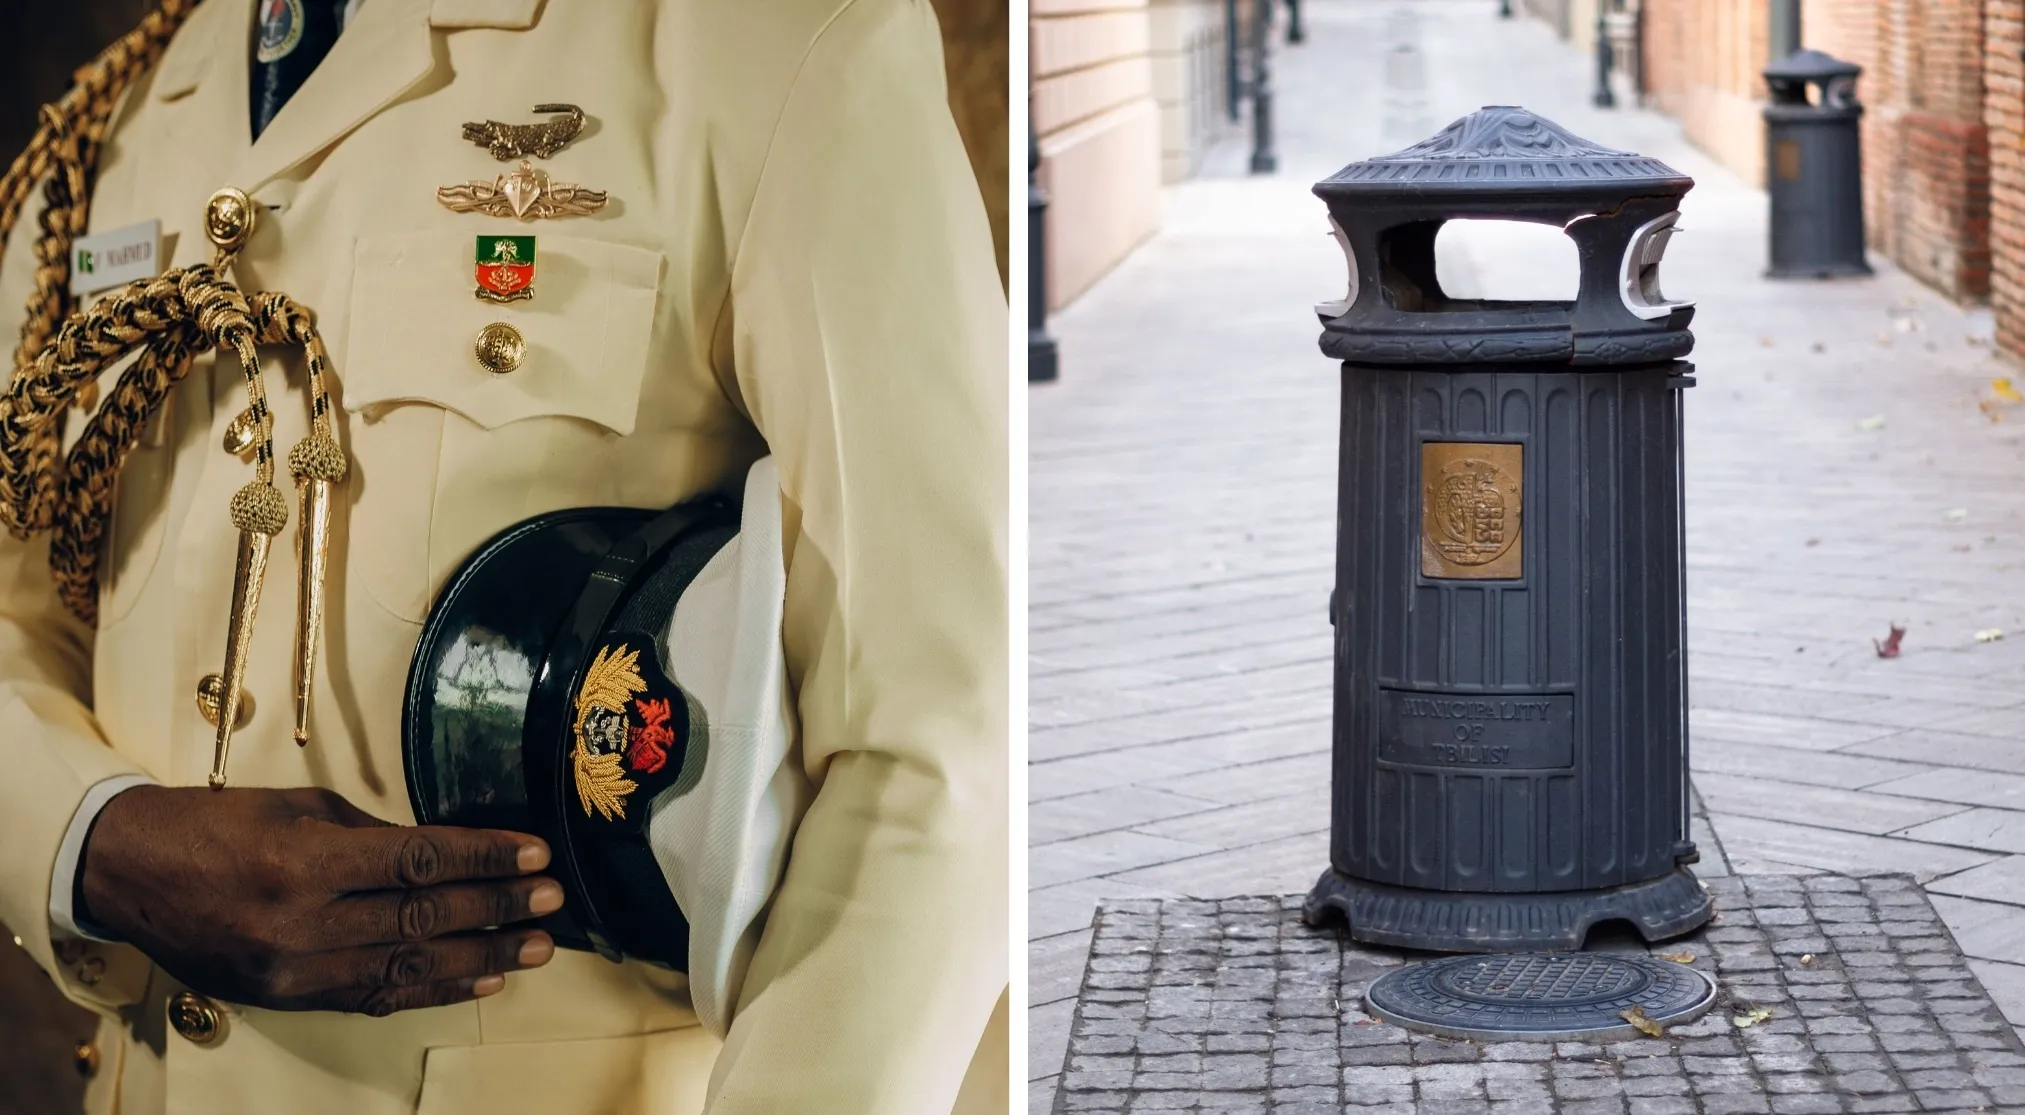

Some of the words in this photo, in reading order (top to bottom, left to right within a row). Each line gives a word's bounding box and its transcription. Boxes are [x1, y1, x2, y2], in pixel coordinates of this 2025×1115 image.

[1402, 698, 1551, 721] MUNICIPALITY
[1453, 723, 1486, 742] OF
[1432, 743, 1512, 765] TBILISI
